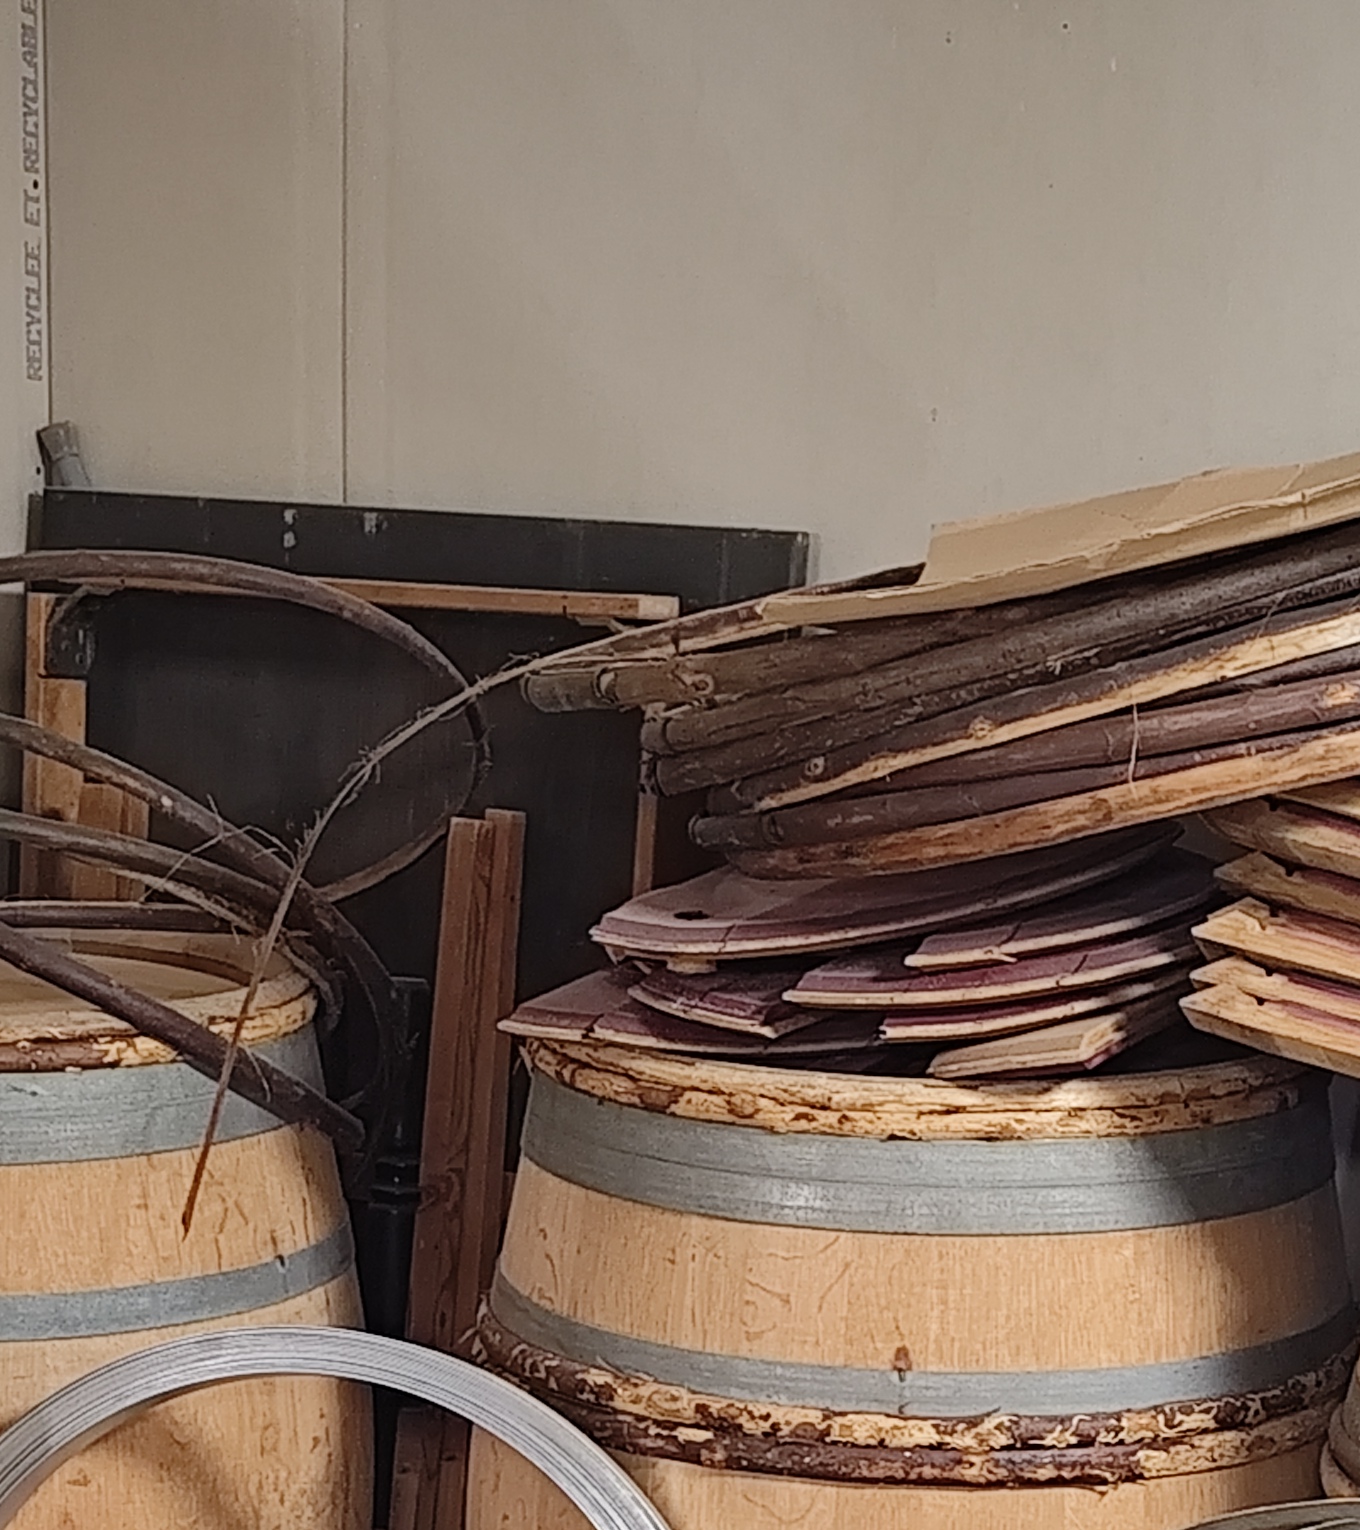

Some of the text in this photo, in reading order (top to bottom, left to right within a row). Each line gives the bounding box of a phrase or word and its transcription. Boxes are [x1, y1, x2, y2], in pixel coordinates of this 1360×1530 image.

[20, 0, 42, 382] RECYCLEE ET RECYCLABLE
